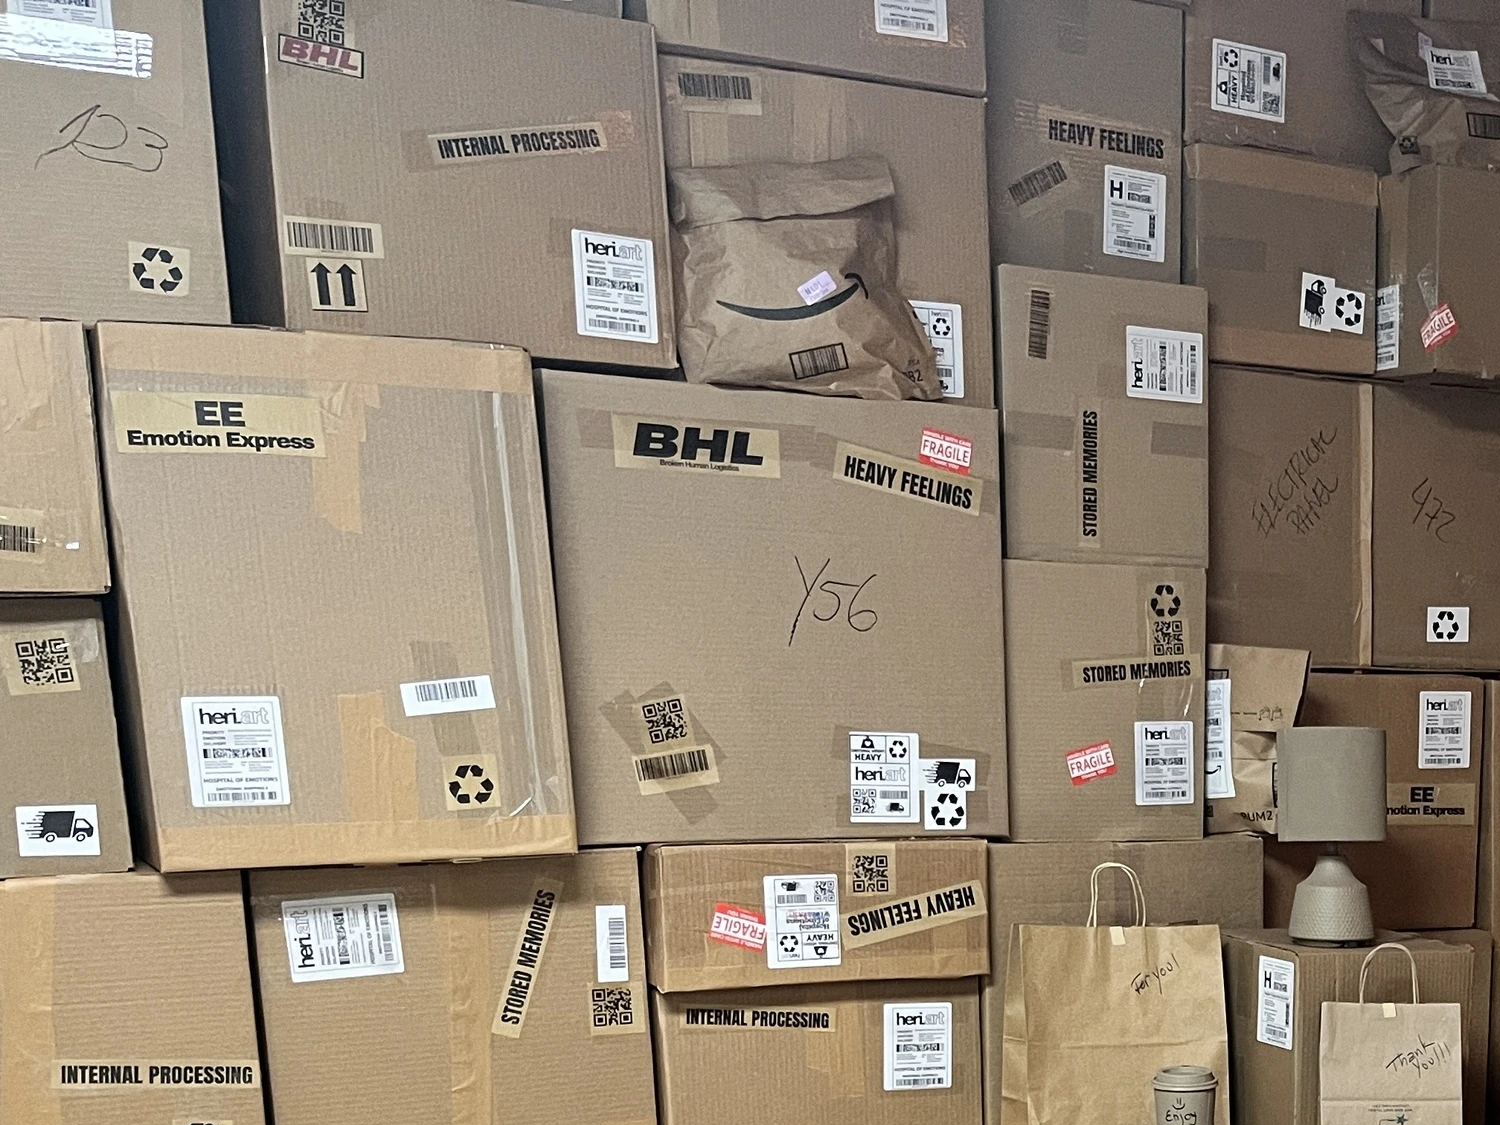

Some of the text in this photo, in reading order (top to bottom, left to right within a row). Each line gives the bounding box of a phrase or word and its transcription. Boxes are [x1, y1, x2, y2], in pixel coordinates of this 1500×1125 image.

[281, 38, 359, 71] BHL
[437, 127, 601, 160] INTERNAL PROCESSING
[1048, 119, 1165, 158] HEAVY FEELINGS
[1110, 179, 1124, 200] H
[1424, 311, 1456, 346] FRAGILE
[195, 401, 245, 427] EE
[127, 430, 315, 456] Emotion Express
[633, 422, 764, 465] BHL
[922, 438, 972, 464] FRAGILE
[844, 455, 897, 490] HEAVY
[900, 476, 973, 510] FEELINGS
[1082, 410, 1098, 538] STORED MEMORIES
[788, 556, 880, 647] Y56
[1082, 660, 1191, 684] STORED MEMORIES
[200, 709, 270, 726] heri.art
[854, 753, 882, 761] HEAVY
[1070, 750, 1112, 777] FRAGILE
[855, 766, 906, 782] heri.art
[1410, 786, 1435, 803] EE
[1422, 805, 1466, 818] Express
[848, 885, 977, 937] HEAVY FEELINGS
[297, 909, 316, 969] heri.art
[713, 914, 766, 942] FRAGILE
[806, 934, 834, 944] HEAVY
[501, 888, 556, 1026] STORED MEMORIES
[1264, 970, 1273, 989] H
[686, 1008, 830, 1030] INTERNAL PROCESSING
[1386, 1034, 1435, 1073] Thank
[60, 1064, 254, 1086] INTERNAL PROCESSING
